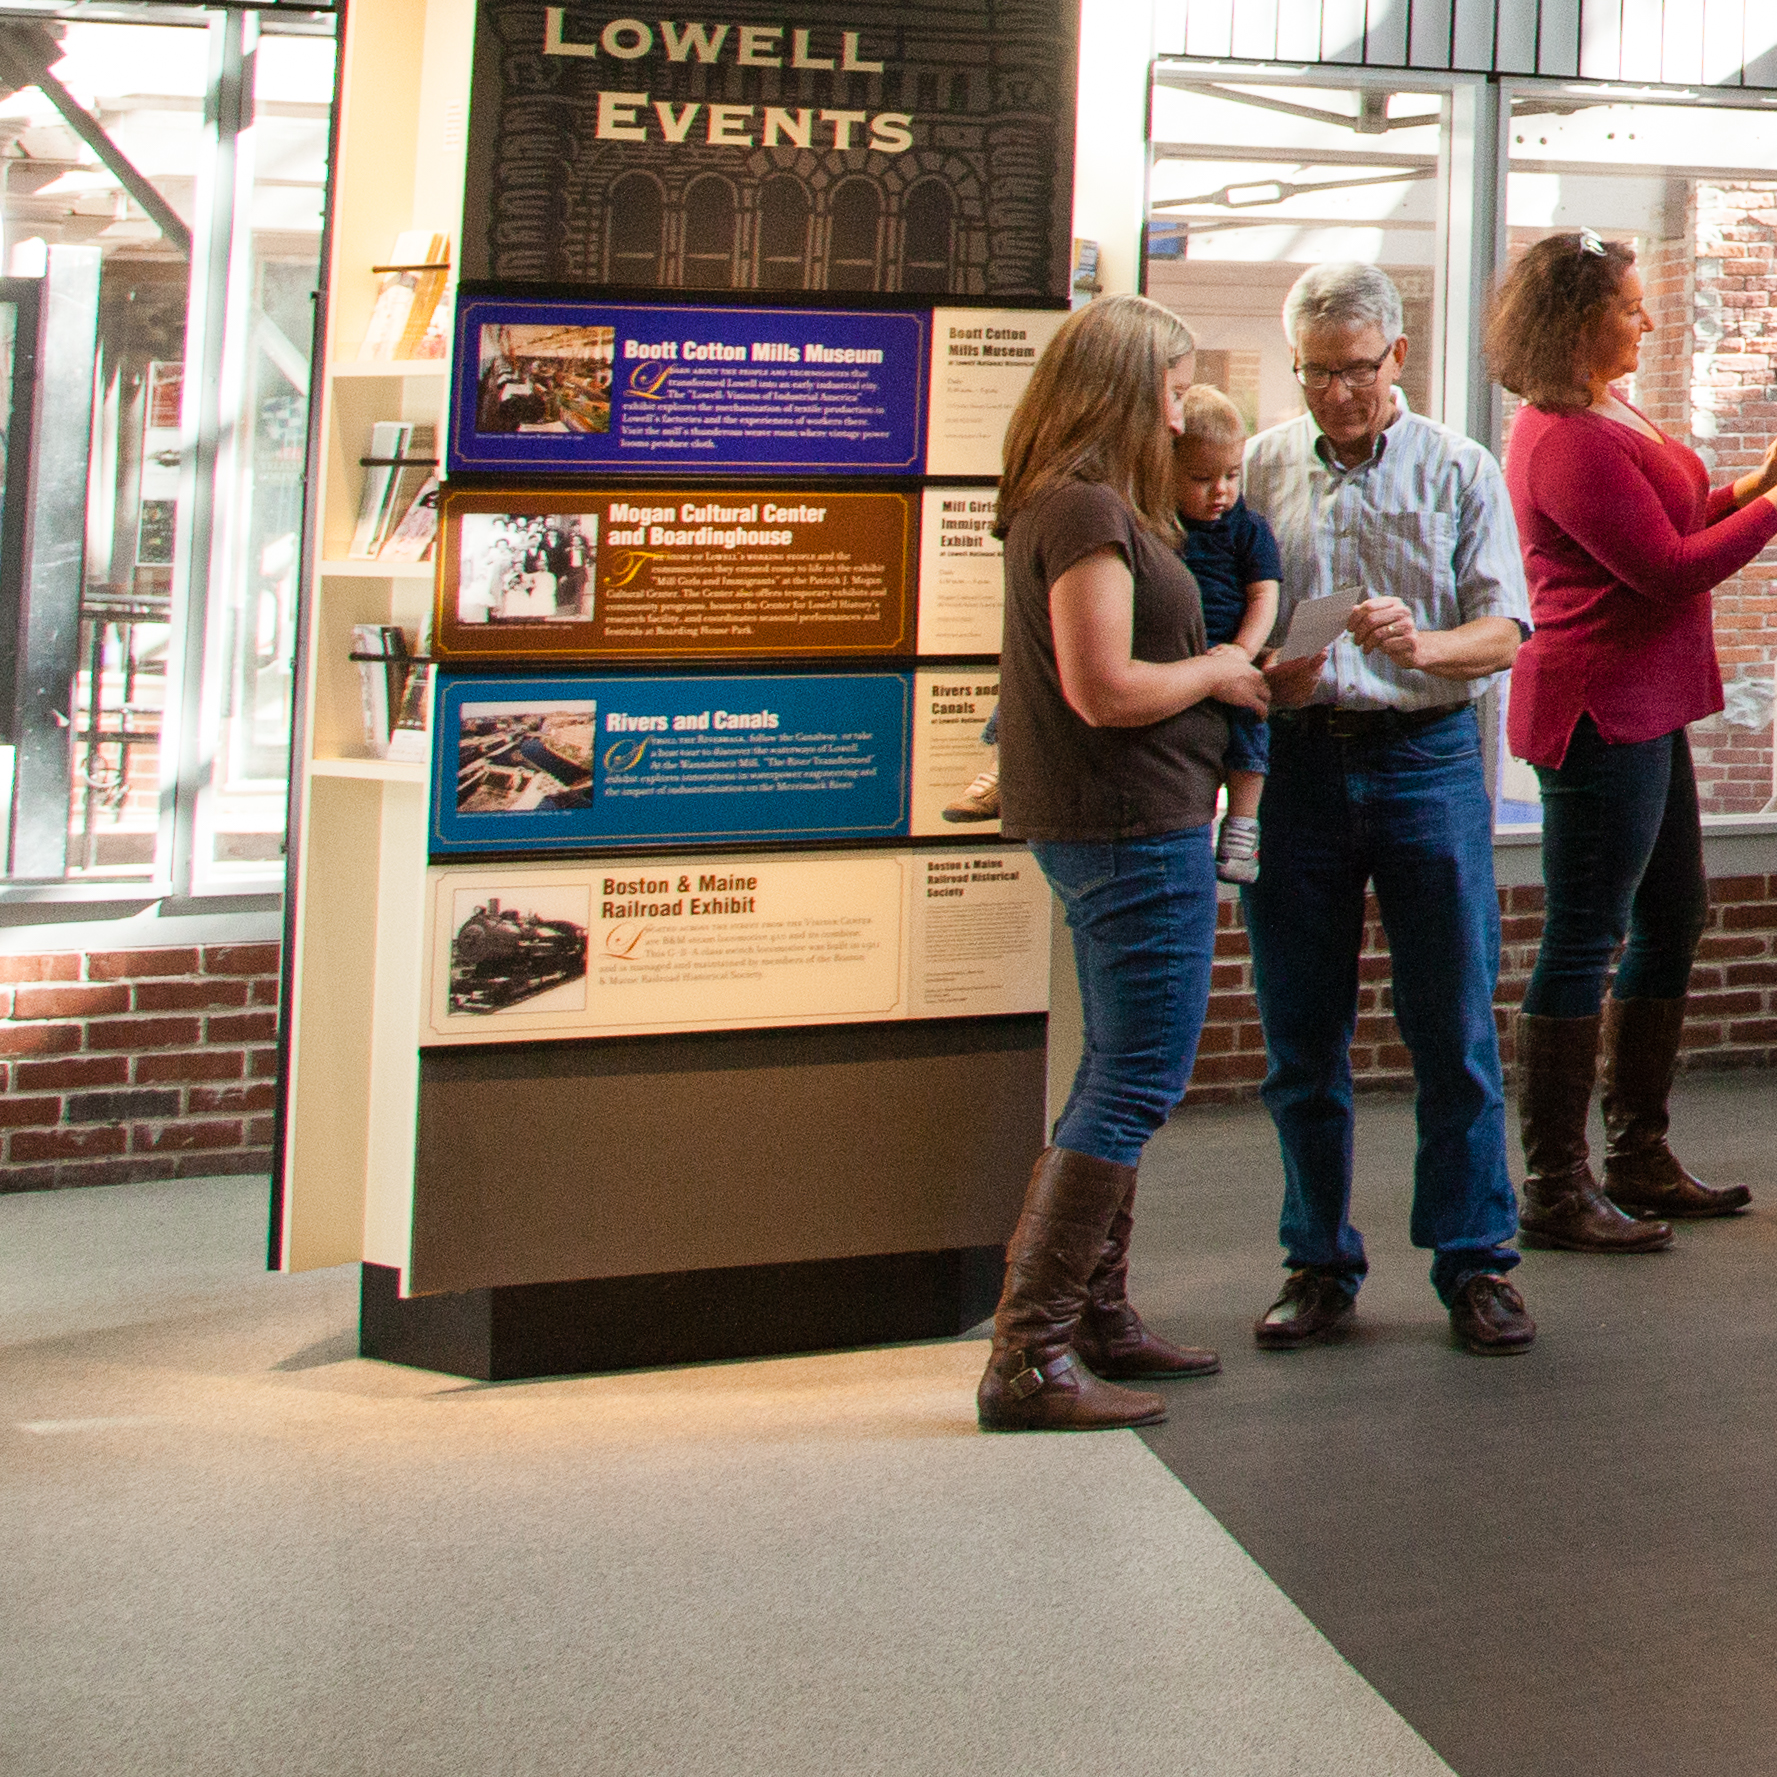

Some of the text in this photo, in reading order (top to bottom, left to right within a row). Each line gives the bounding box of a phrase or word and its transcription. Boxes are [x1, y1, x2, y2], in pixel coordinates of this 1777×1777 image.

[543, 6, 885, 73] LOWELL
[595, 90, 914, 153] EVENTS
[948, 327, 1027, 340] Boott Cotton
[623, 339, 884, 364] Boott Cotton Mills Museum
[948, 344, 1035, 357] Mills Museum
[942, 500, 966, 512] Mill
[608, 503, 827, 527] Mogan Cultural Center
[941, 518, 997, 531] Immigra
[607, 526, 793, 550] and Boardinghouse
[940, 535, 984, 547] Exhibit
[931, 683, 999, 697] Rivers and
[931, 702, 975, 714] Canals
[606, 709, 779, 732] Rivers and Canals
[928, 862, 962, 871] Boston
[973, 859, 1004, 869] Maine
[927, 871, 1020, 884] Railroad Historical
[602, 874, 758, 896] Boston & Maine
[927, 887, 965, 897] Society
[601, 896, 757, 919] Railroad Exhibit
